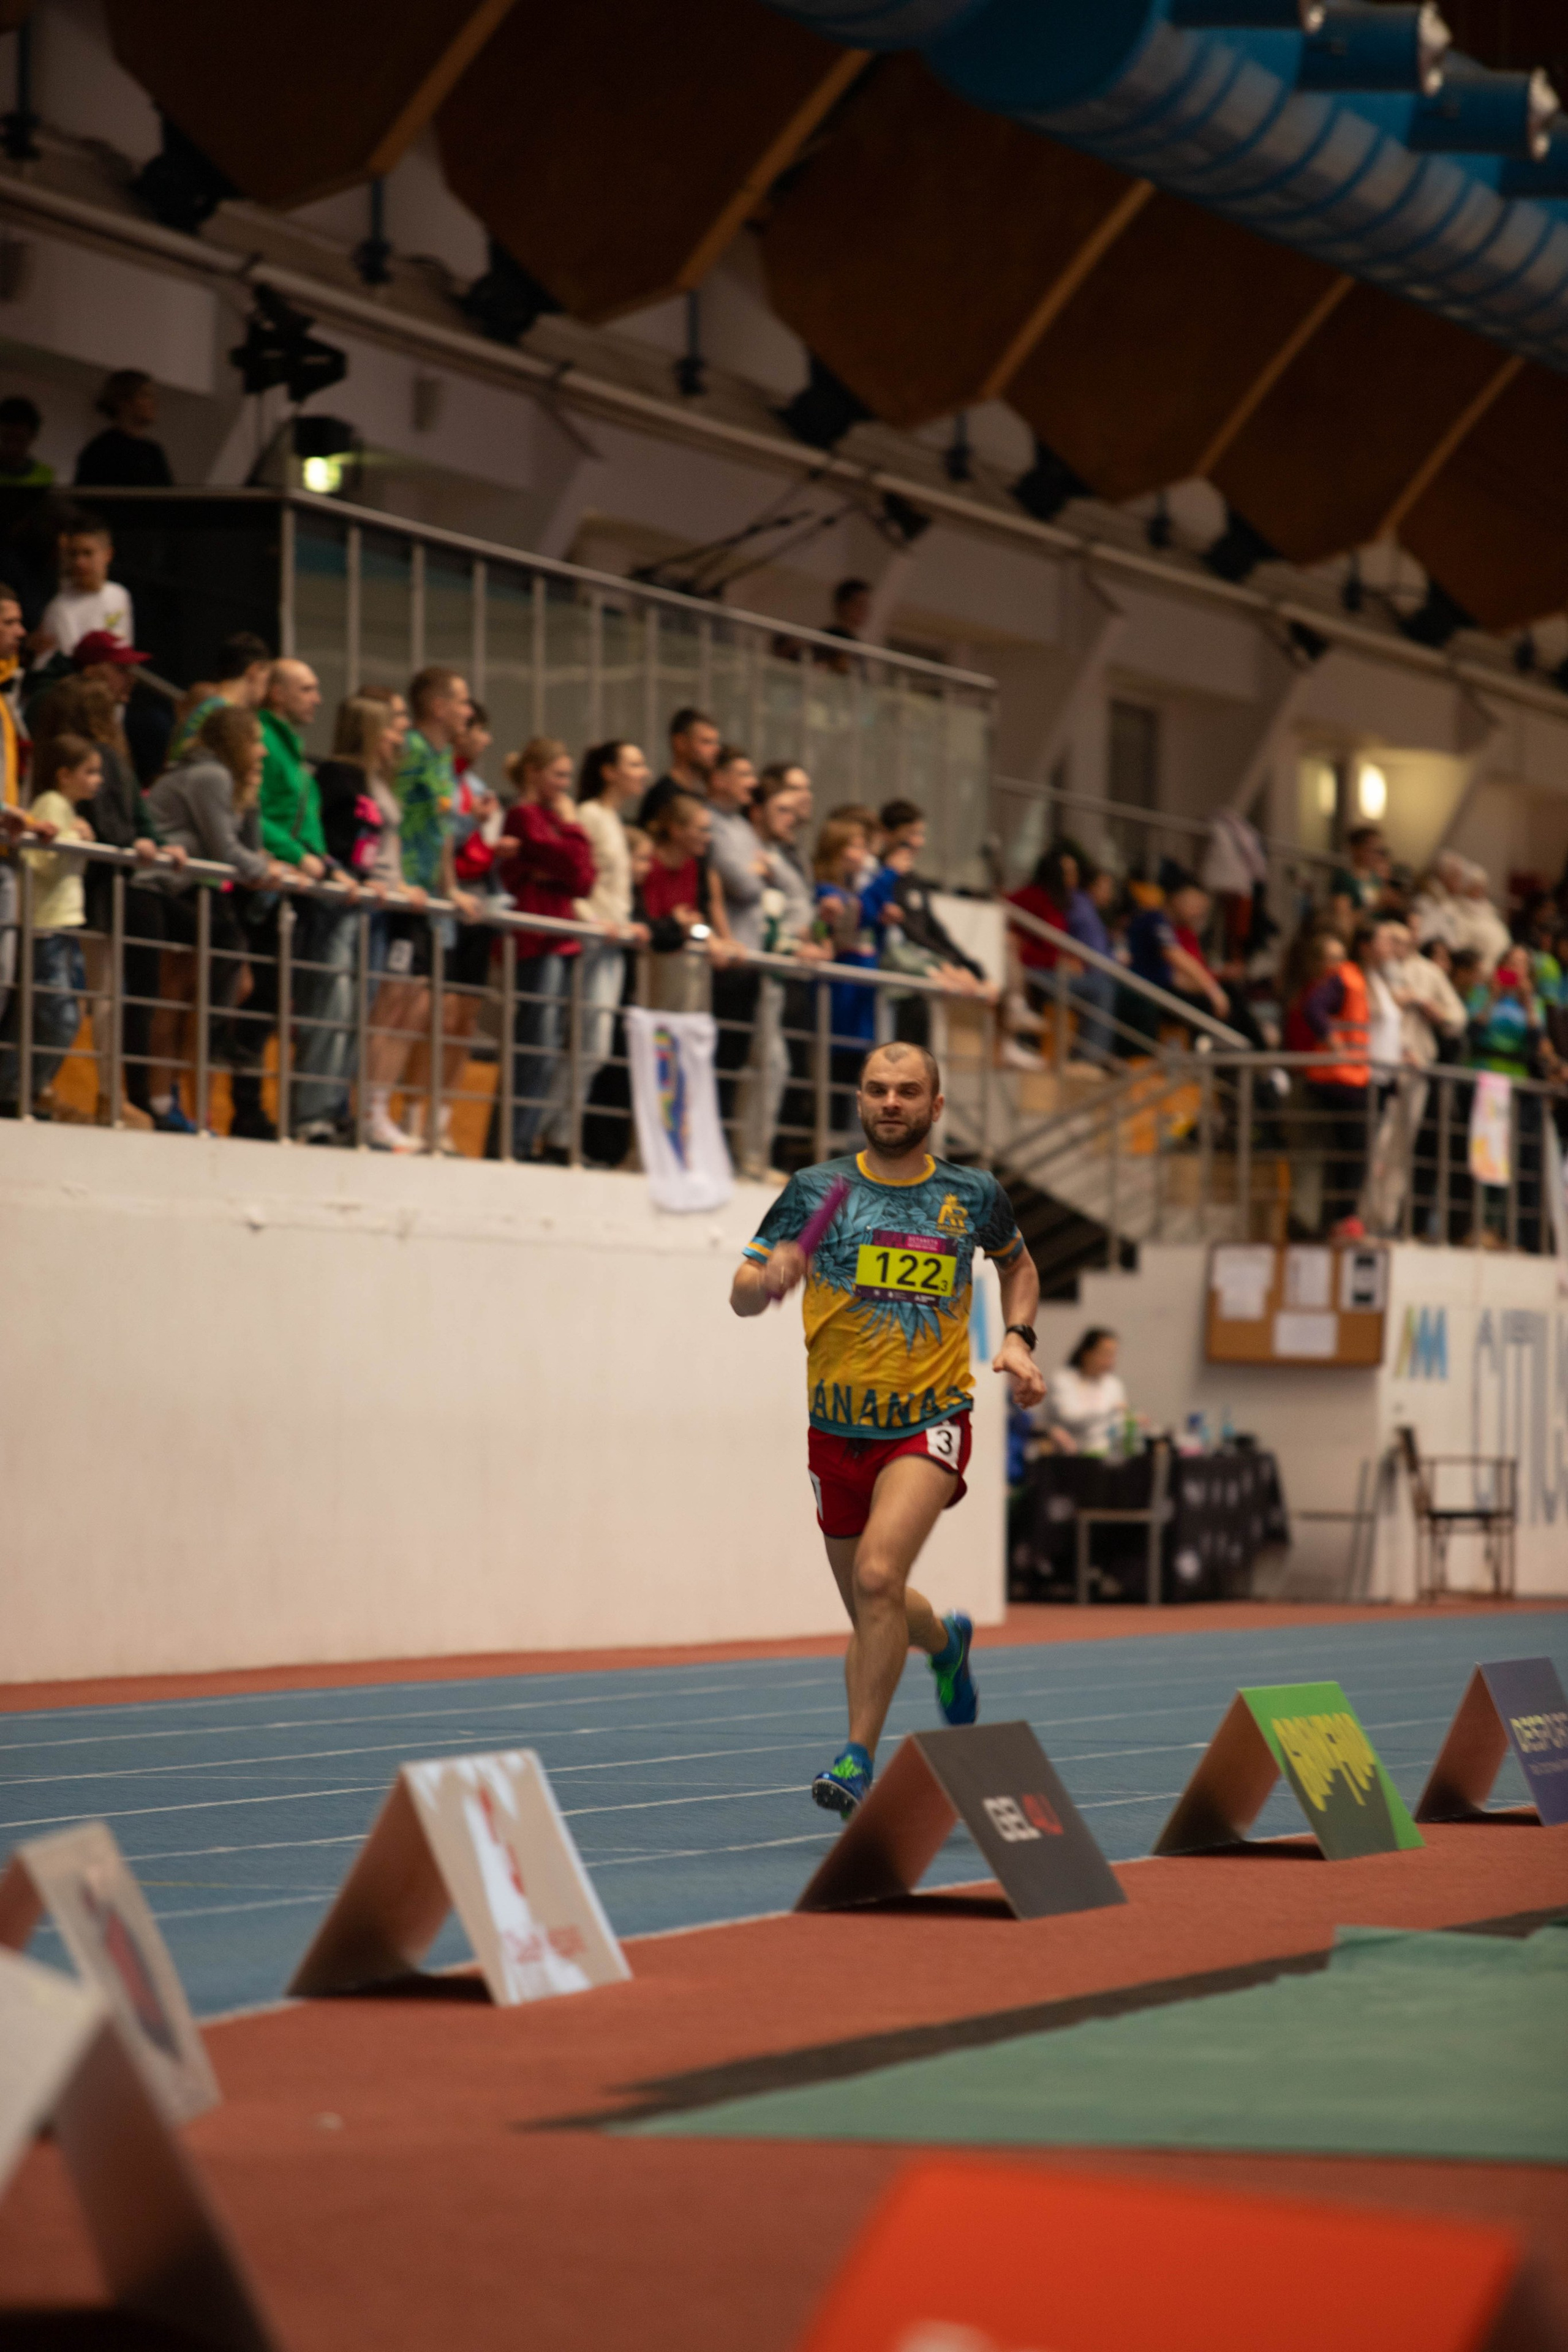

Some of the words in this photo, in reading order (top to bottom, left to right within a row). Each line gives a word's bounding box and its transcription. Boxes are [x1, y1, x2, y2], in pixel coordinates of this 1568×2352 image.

[876, 1251, 941, 1291] 122
[941, 1280, 948, 1292] 3
[937, 1430, 952, 1455] 3
